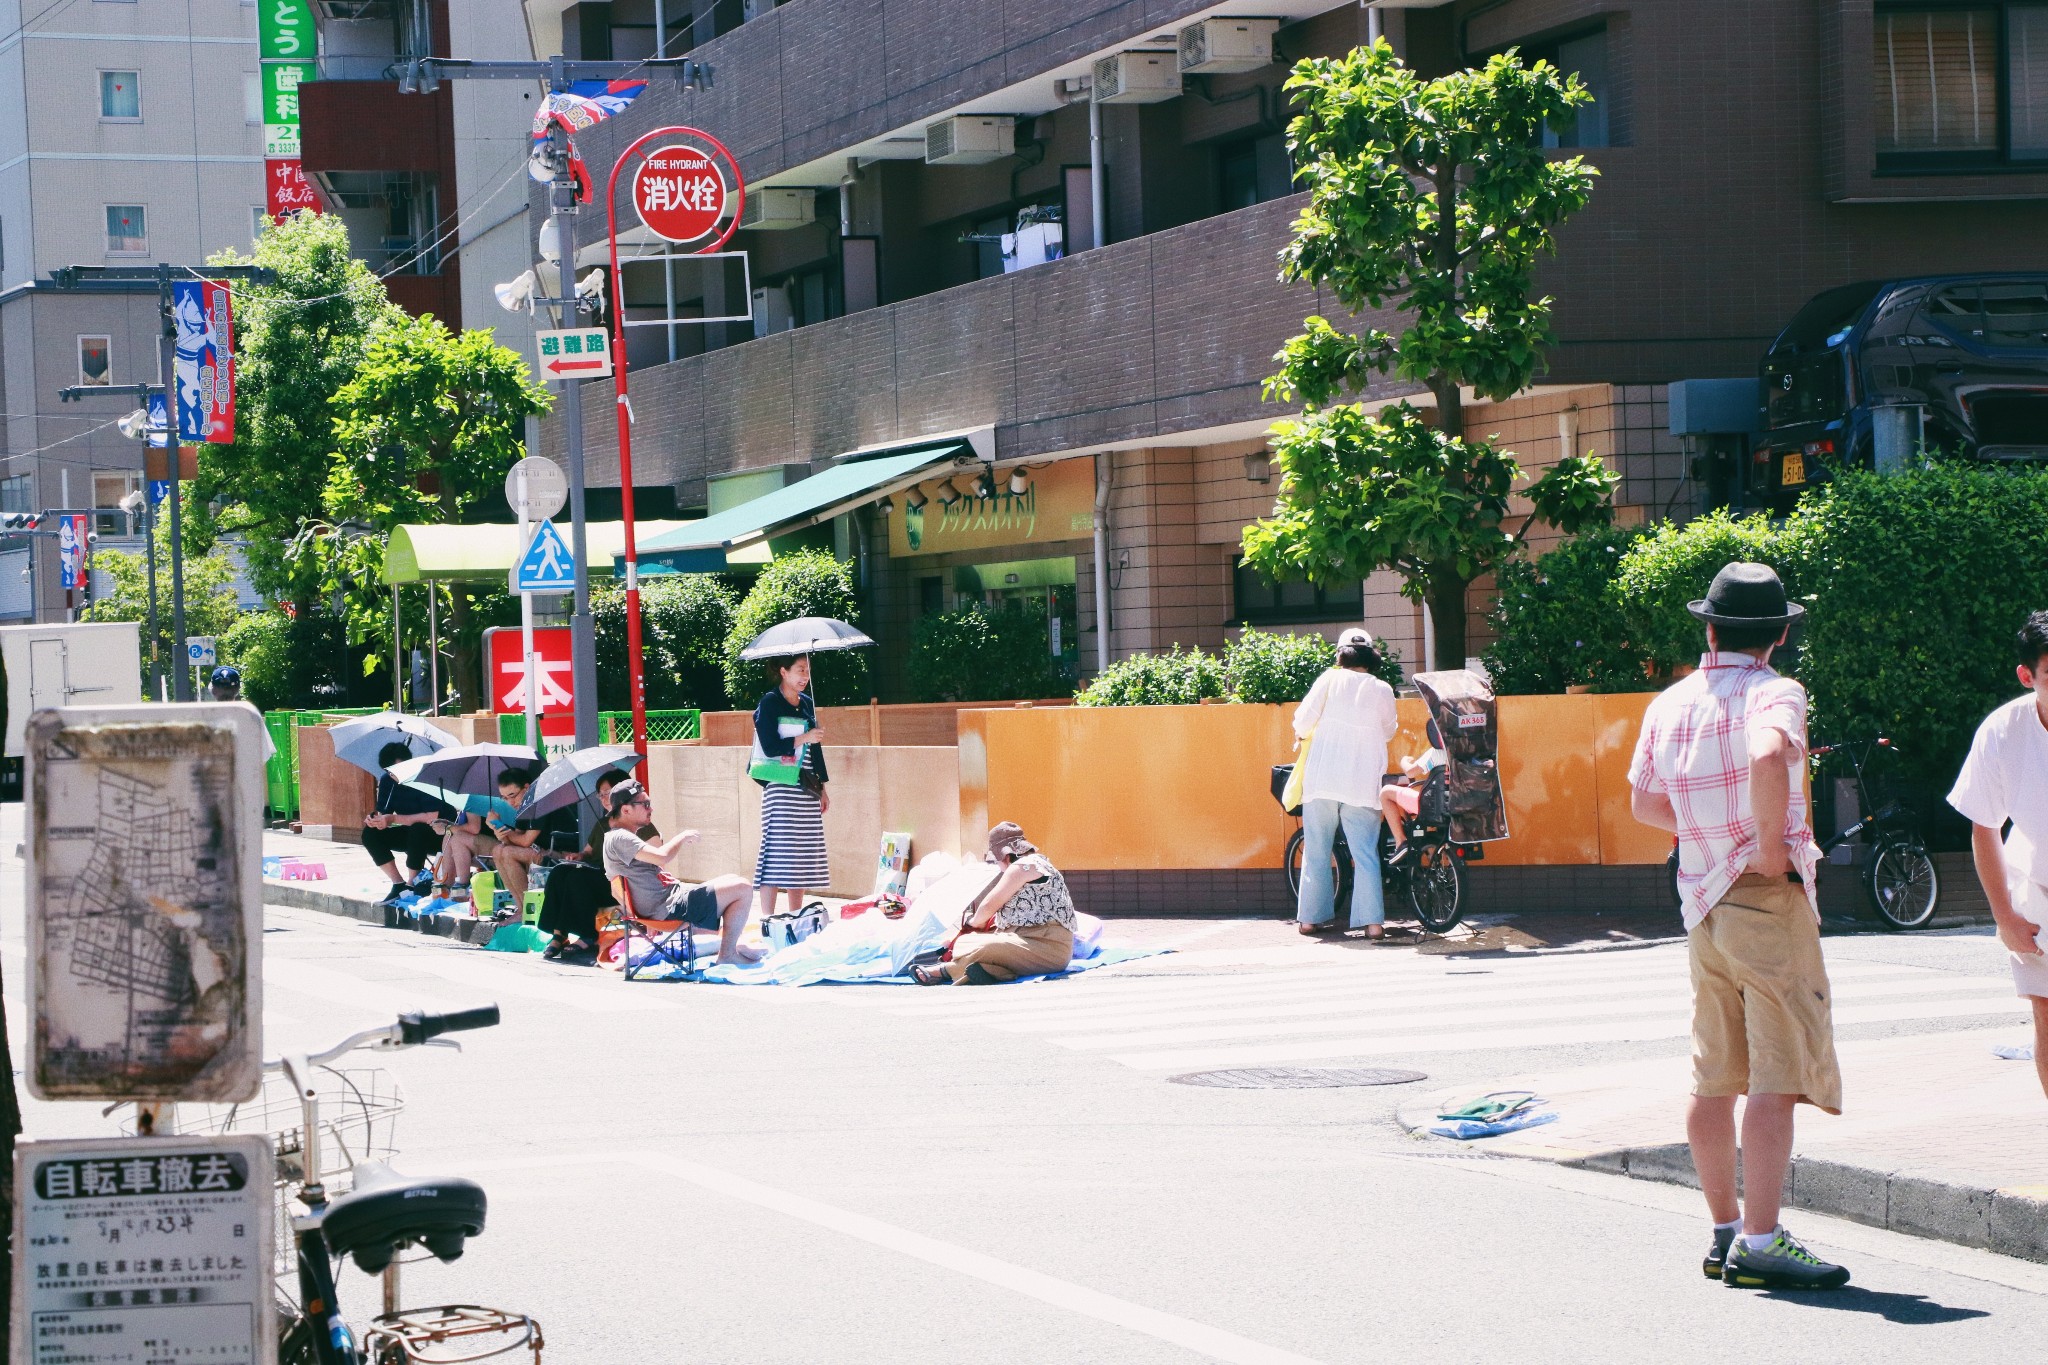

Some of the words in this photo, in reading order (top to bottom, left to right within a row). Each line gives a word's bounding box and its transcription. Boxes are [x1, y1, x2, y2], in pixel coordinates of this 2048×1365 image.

[277, 126, 300, 140] 2
[648, 159, 668, 170] FIRE
[669, 159, 708, 170] HYDRANT
[275, 184, 314, 203] 飯店
[642, 175, 718, 212] 消火栓
[541, 333, 605, 356] 避難路
[501, 651, 573, 714] 本
[46, 1157, 233, 1198] 自転車撤去
